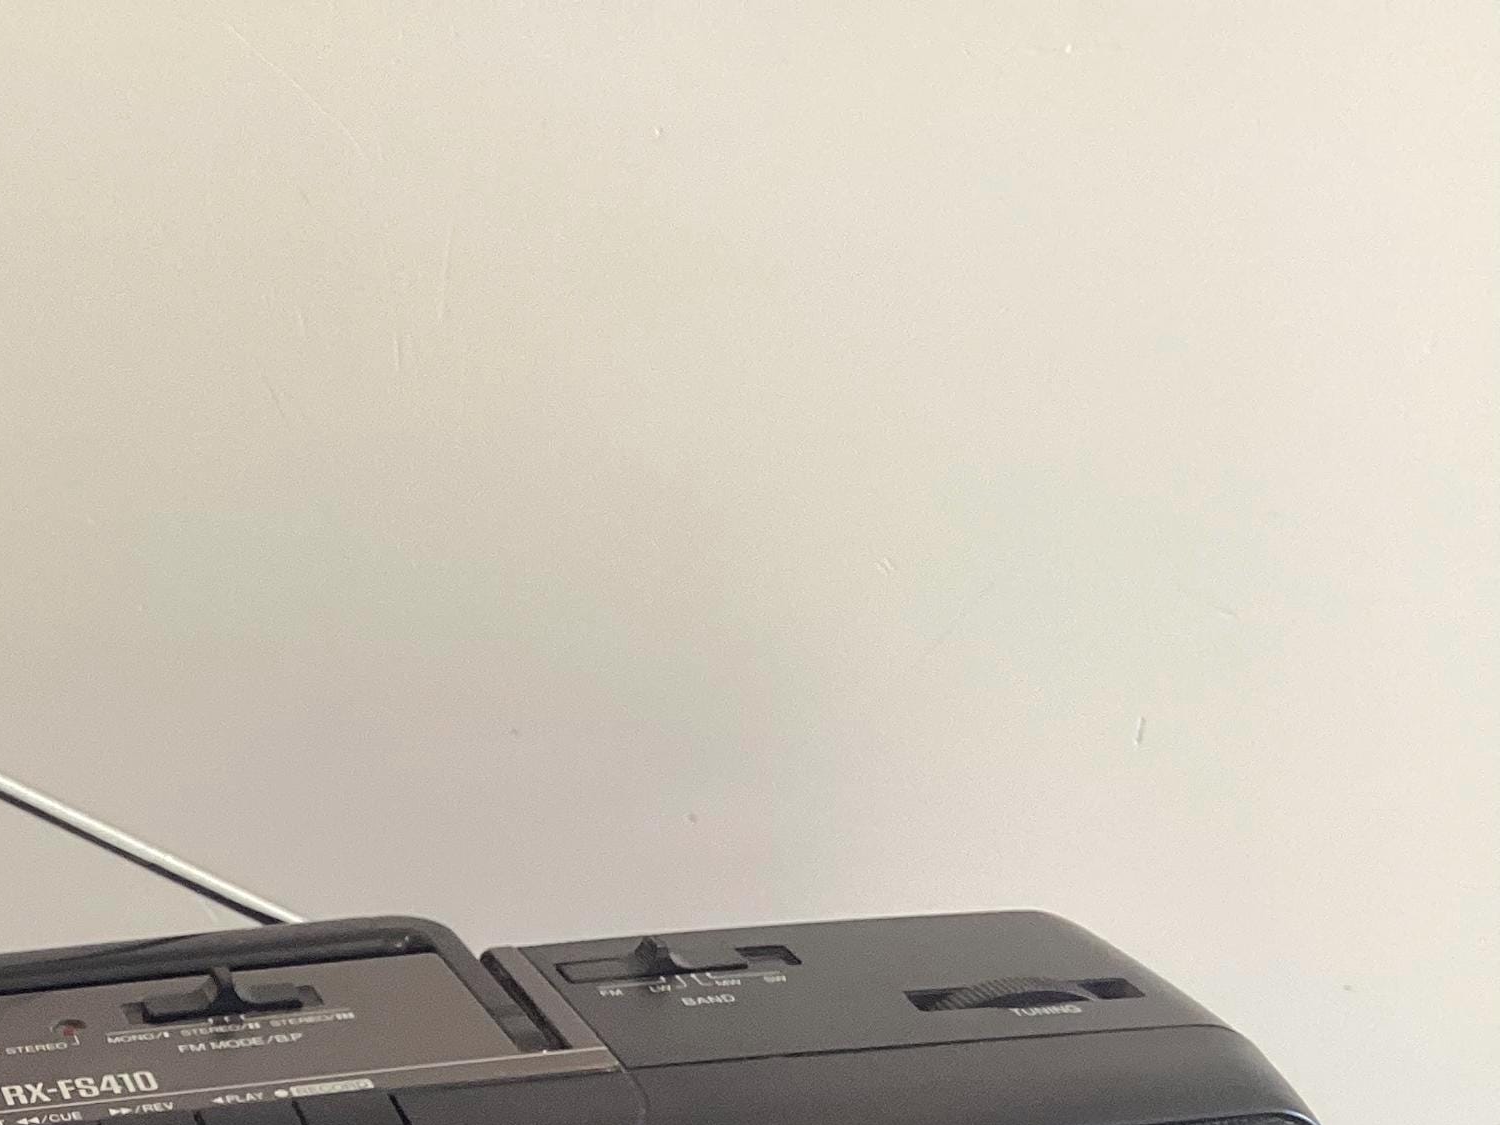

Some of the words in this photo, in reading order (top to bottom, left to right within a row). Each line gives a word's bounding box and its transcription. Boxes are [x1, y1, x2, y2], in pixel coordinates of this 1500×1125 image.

[681, 993, 736, 1006] BAND
[1008, 1004, 1082, 1017] TUNING
[5, 1041, 69, 1056] STEREO
[177, 1043, 206, 1054] FM
[0, 1071, 160, 1106] RX-FS410
[224, 1091, 265, 1104] PLAY
